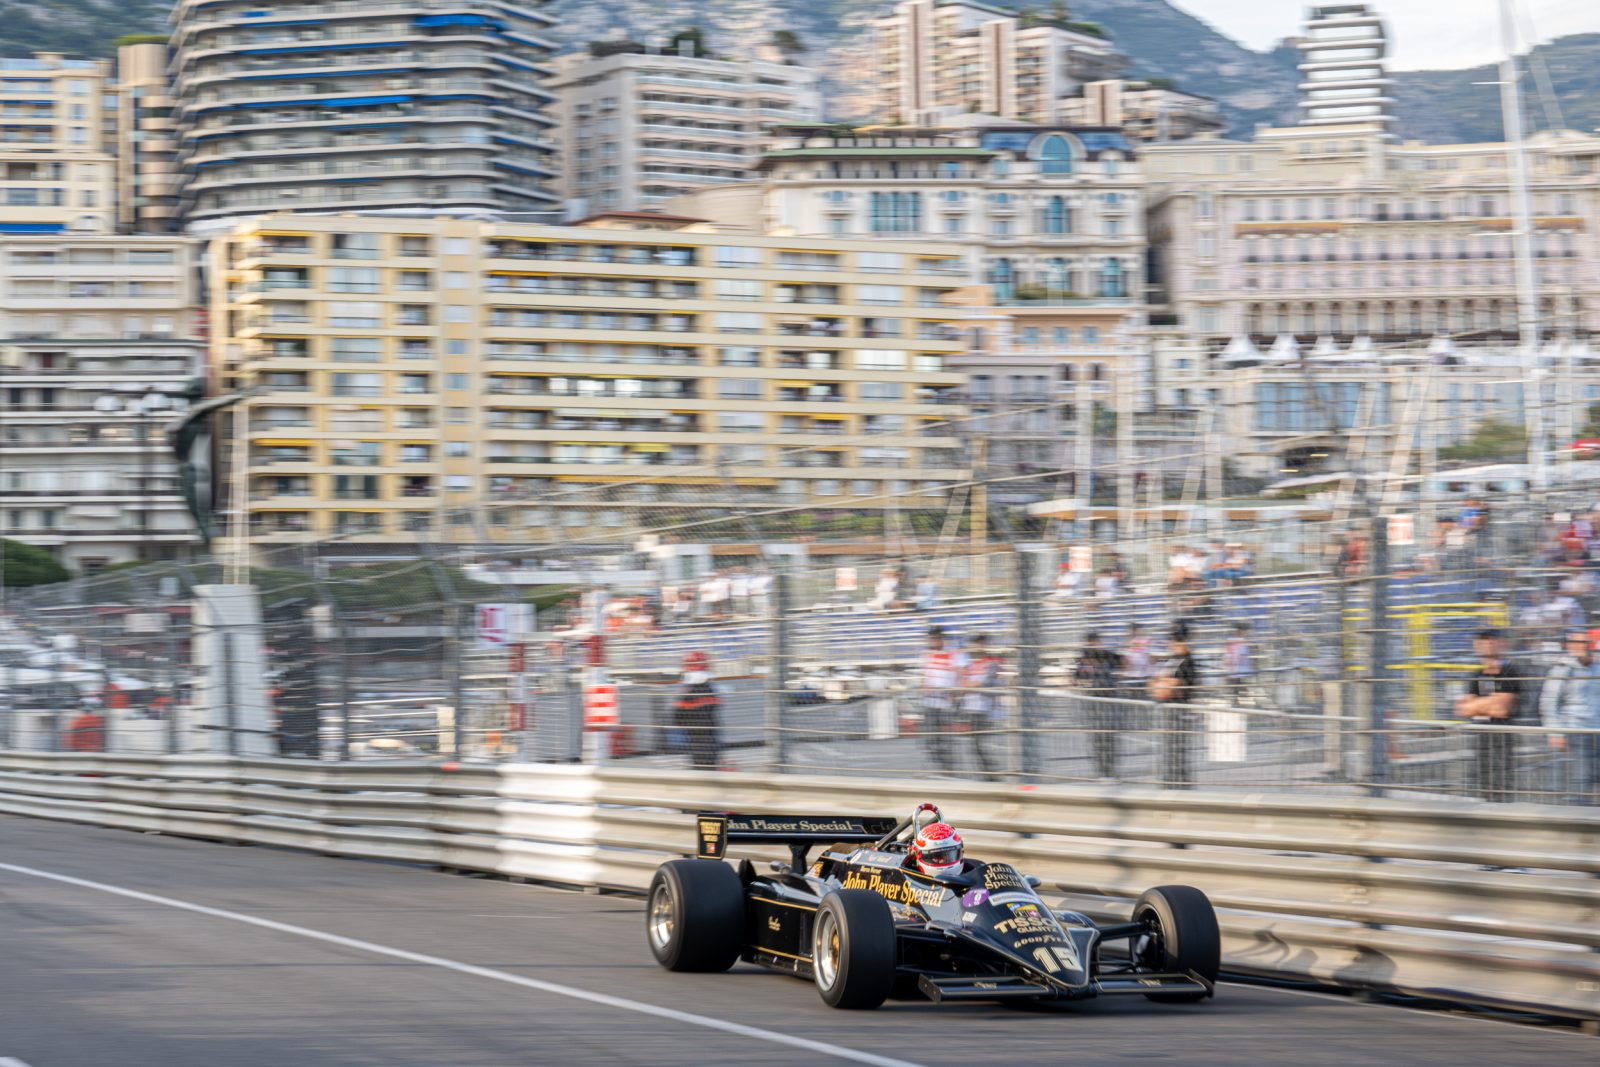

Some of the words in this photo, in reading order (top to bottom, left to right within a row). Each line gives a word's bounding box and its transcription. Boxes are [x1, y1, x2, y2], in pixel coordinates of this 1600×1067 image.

[727, 819, 750, 830] ohn
[751, 820, 798, 831] Player
[800, 821, 853, 832] Special
[987, 864, 1013, 874] John
[984, 872, 1020, 883] Player
[842, 871, 867, 890] John
[868, 874, 901, 900] Player
[900, 880, 947, 908] Special
[985, 880, 1026, 890] Special
[994, 916, 1058, 934] TISSO
[1033, 946, 1084, 973] 15
